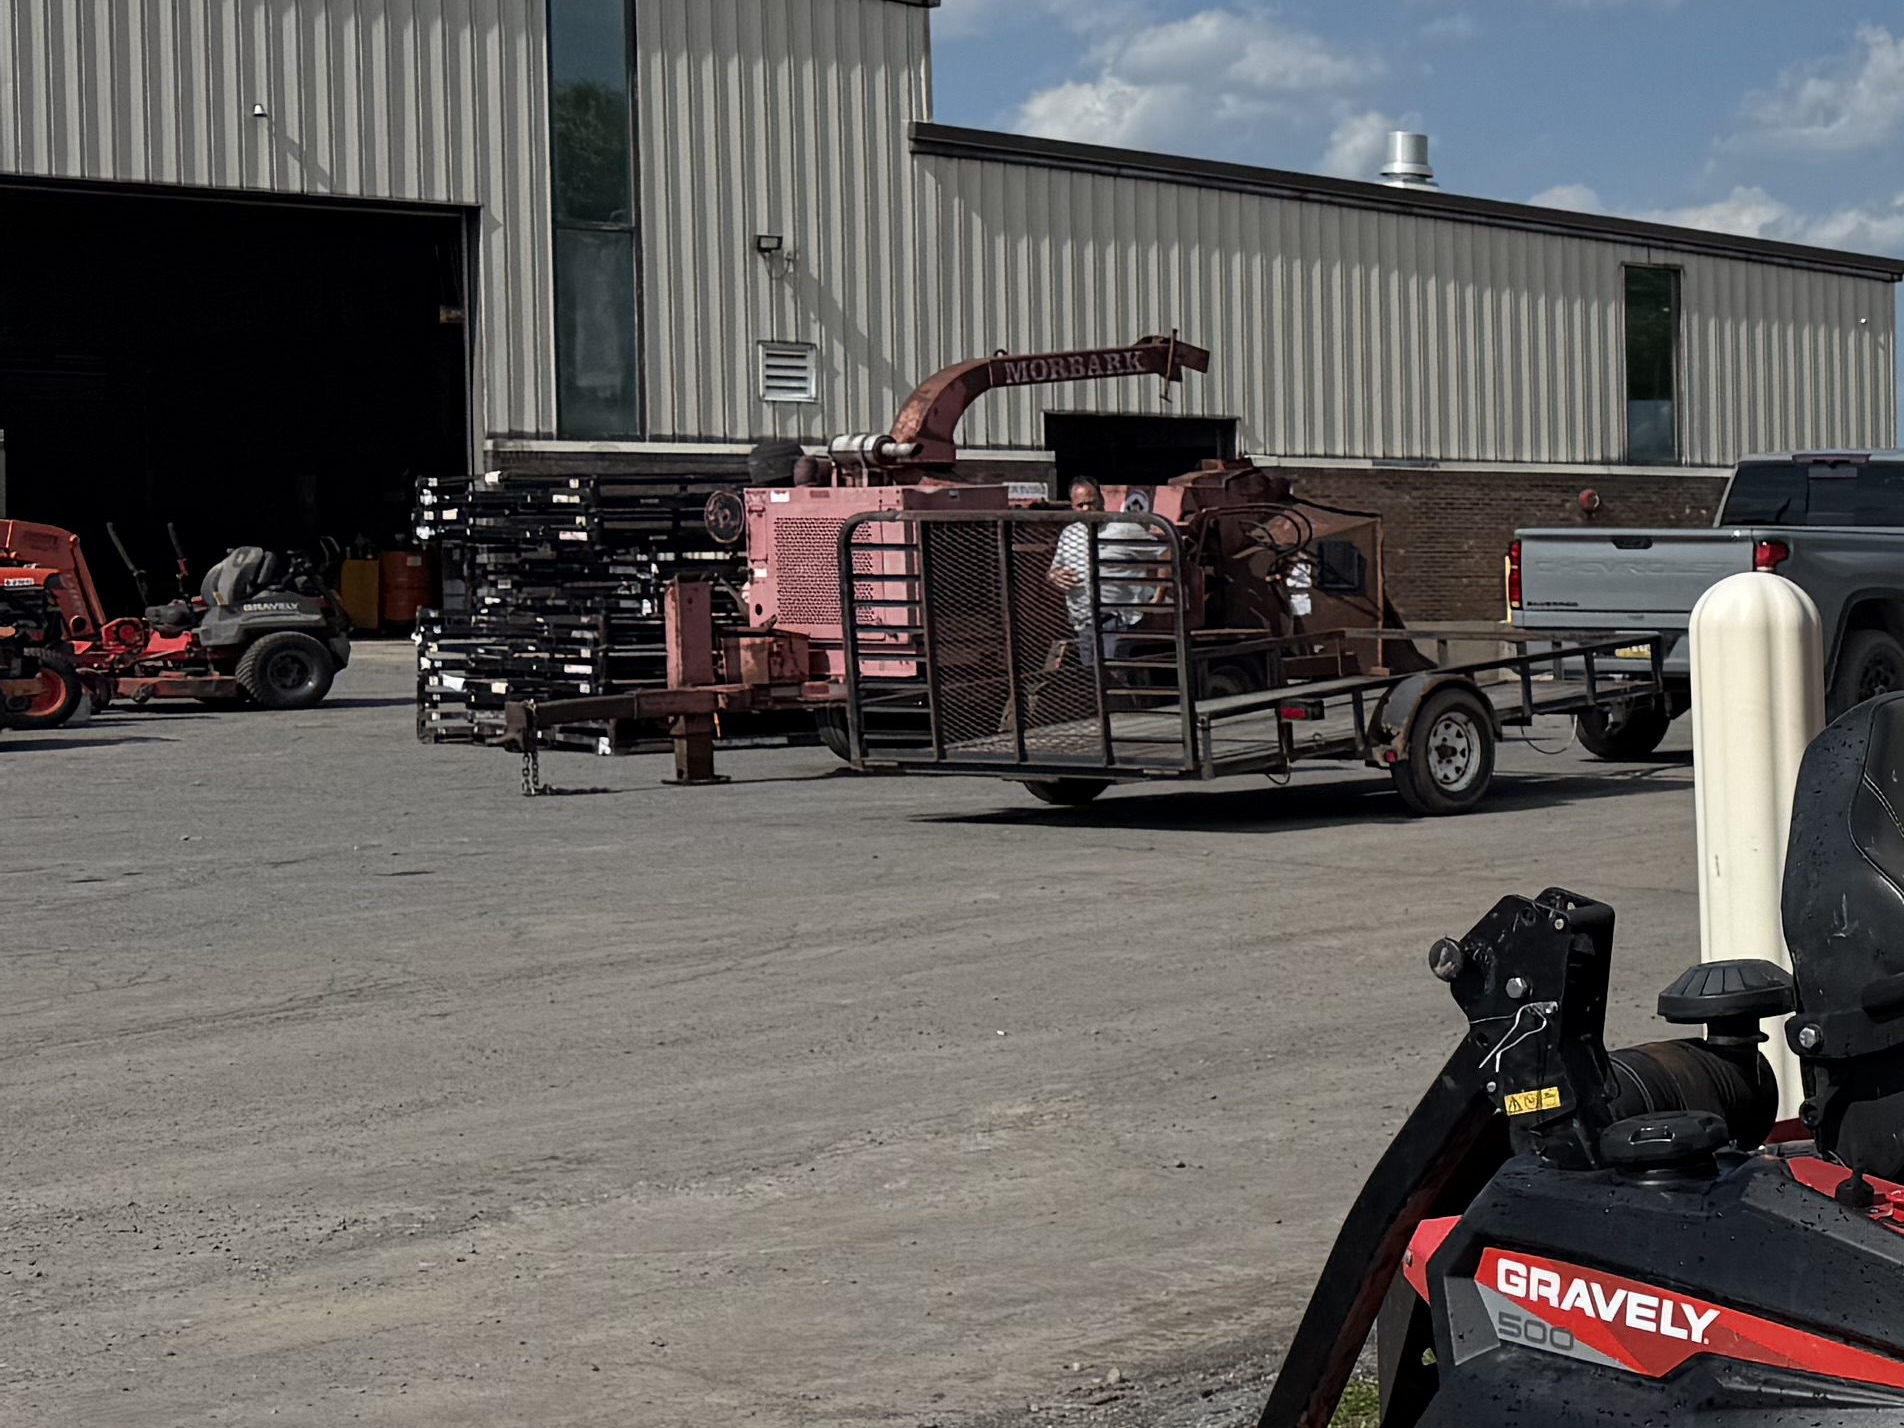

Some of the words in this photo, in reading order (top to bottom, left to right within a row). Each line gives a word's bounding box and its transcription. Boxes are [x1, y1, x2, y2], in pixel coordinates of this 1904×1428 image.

[1004, 350, 1147, 384] MORBARK
[242, 602, 299, 612] GRAVELY
[1496, 1258, 1720, 1345] GRAVELY
[1497, 1310, 1575, 1352] 500
